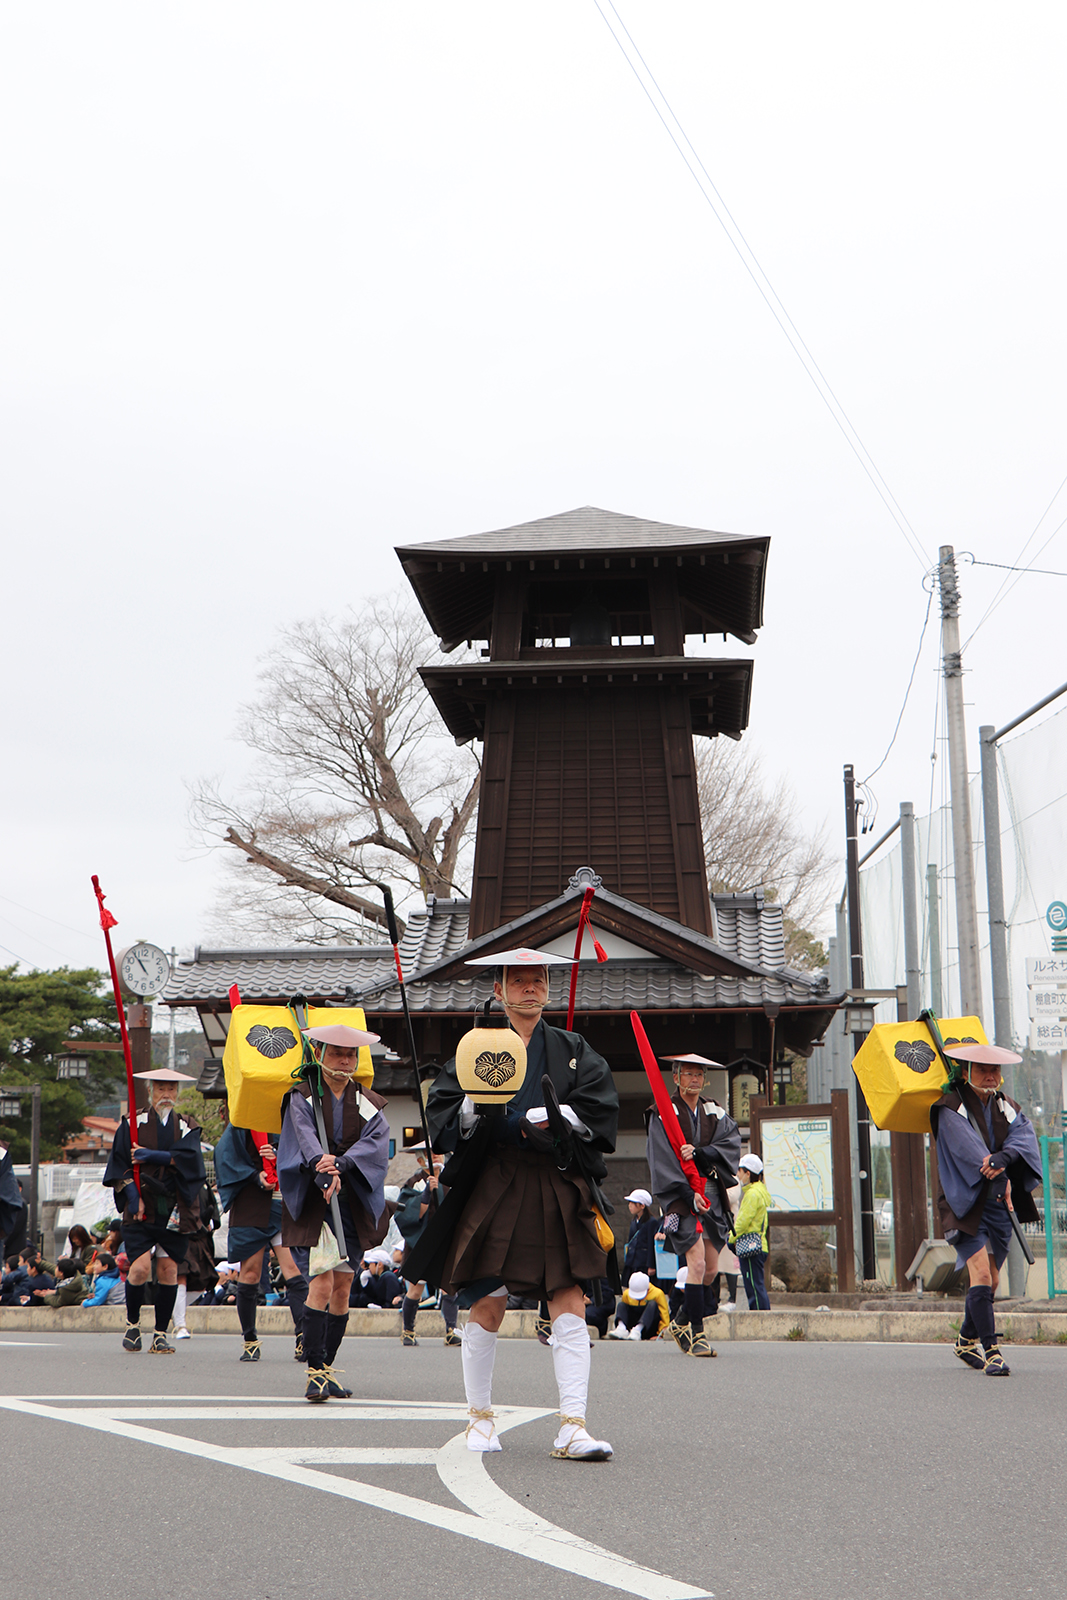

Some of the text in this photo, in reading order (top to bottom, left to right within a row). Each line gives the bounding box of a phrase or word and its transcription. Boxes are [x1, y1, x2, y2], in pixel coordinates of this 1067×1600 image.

[141, 949, 149, 957] 12
[126, 956, 134, 964] 10
[125, 965, 130, 973] 9
[141, 982, 146, 990] 6
[1037, 1025, 1067, 1038] 総合
